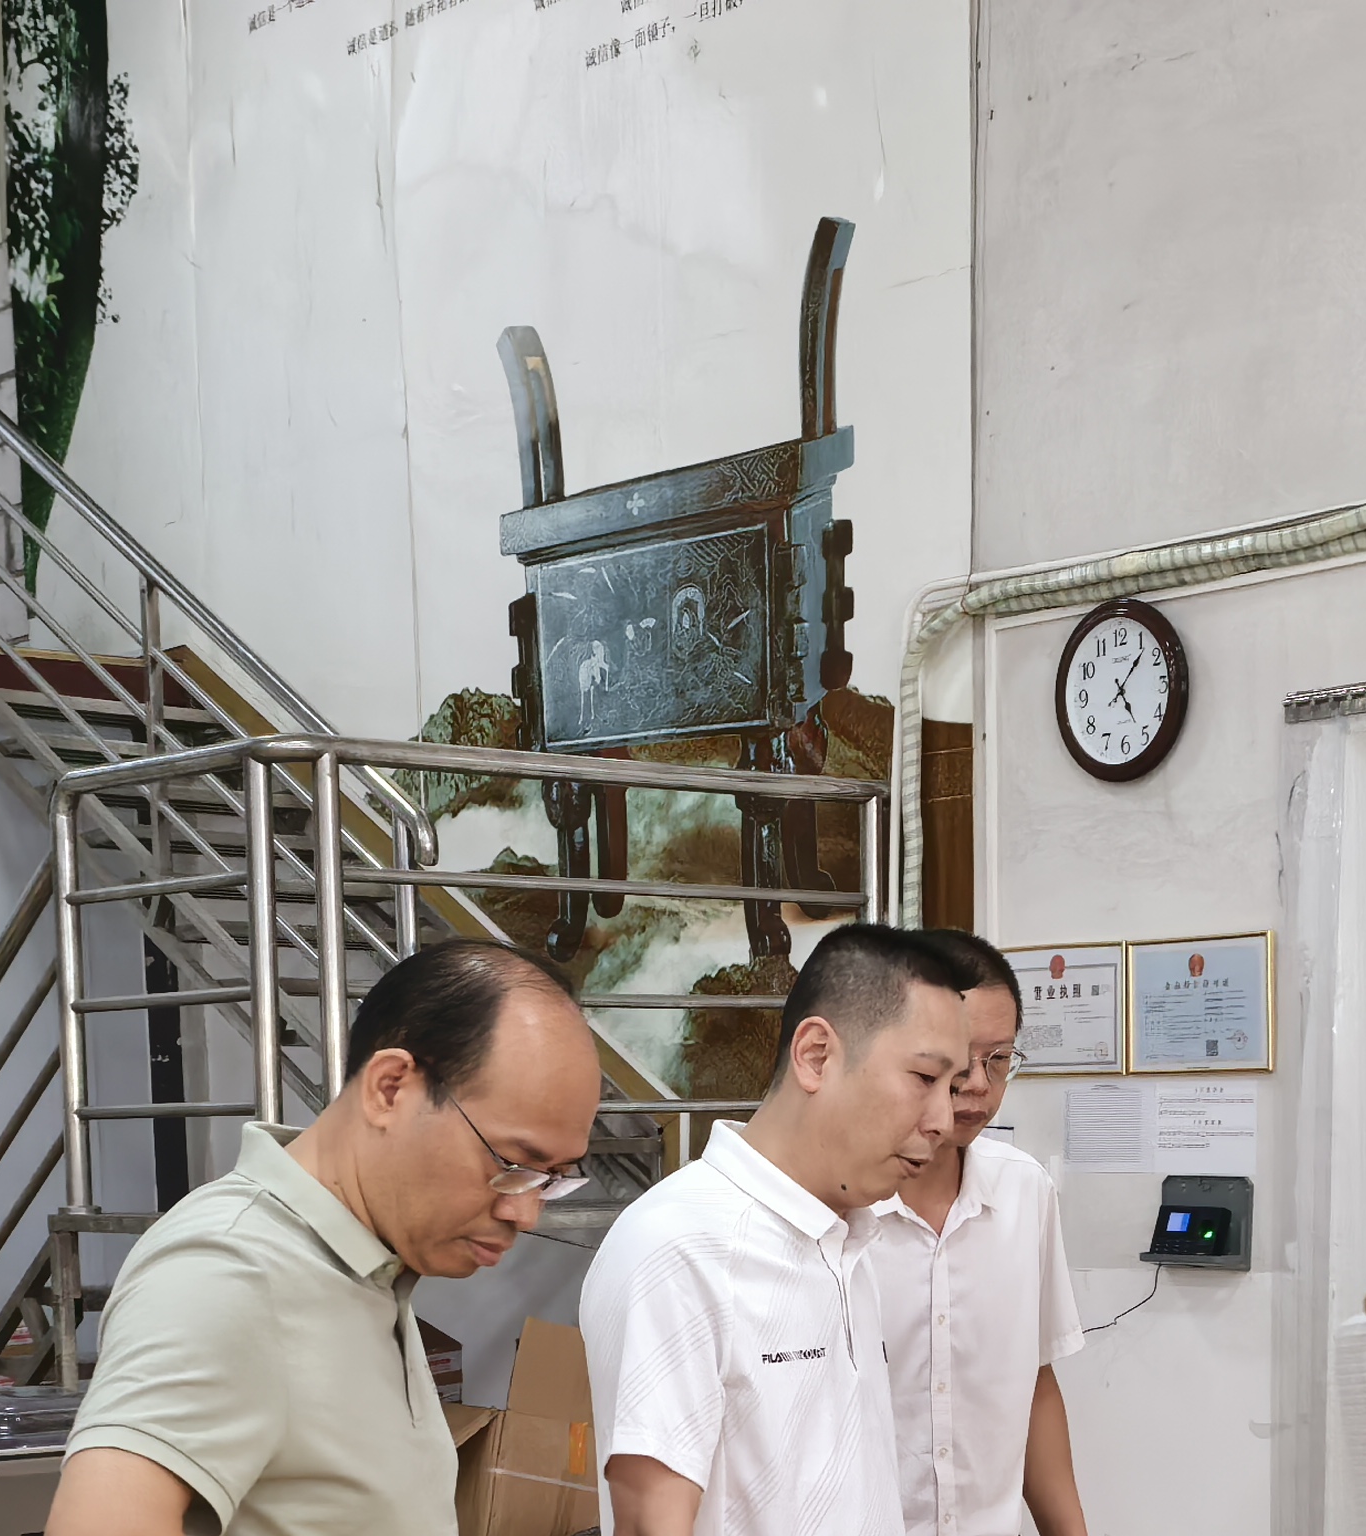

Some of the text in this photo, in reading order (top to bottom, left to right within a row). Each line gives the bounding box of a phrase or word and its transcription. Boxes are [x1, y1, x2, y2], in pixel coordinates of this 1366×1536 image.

[1112, 627, 1127, 647] 12
[1137, 631, 1143, 649] 1
[1095, 637, 1106, 657] 11
[1152, 647, 1161, 666] 2
[1081, 660, 1095, 680] 10
[1158, 675, 1168, 693] 3
[1078, 689, 1088, 708] 9
[1152, 702, 1163, 721] 4
[1085, 715, 1095, 734] 8
[1100, 732, 1111, 751] 7
[1120, 734, 1130, 755] 6
[1140, 725, 1149, 746] 5
[761, 1353, 784, 1364] FILA
